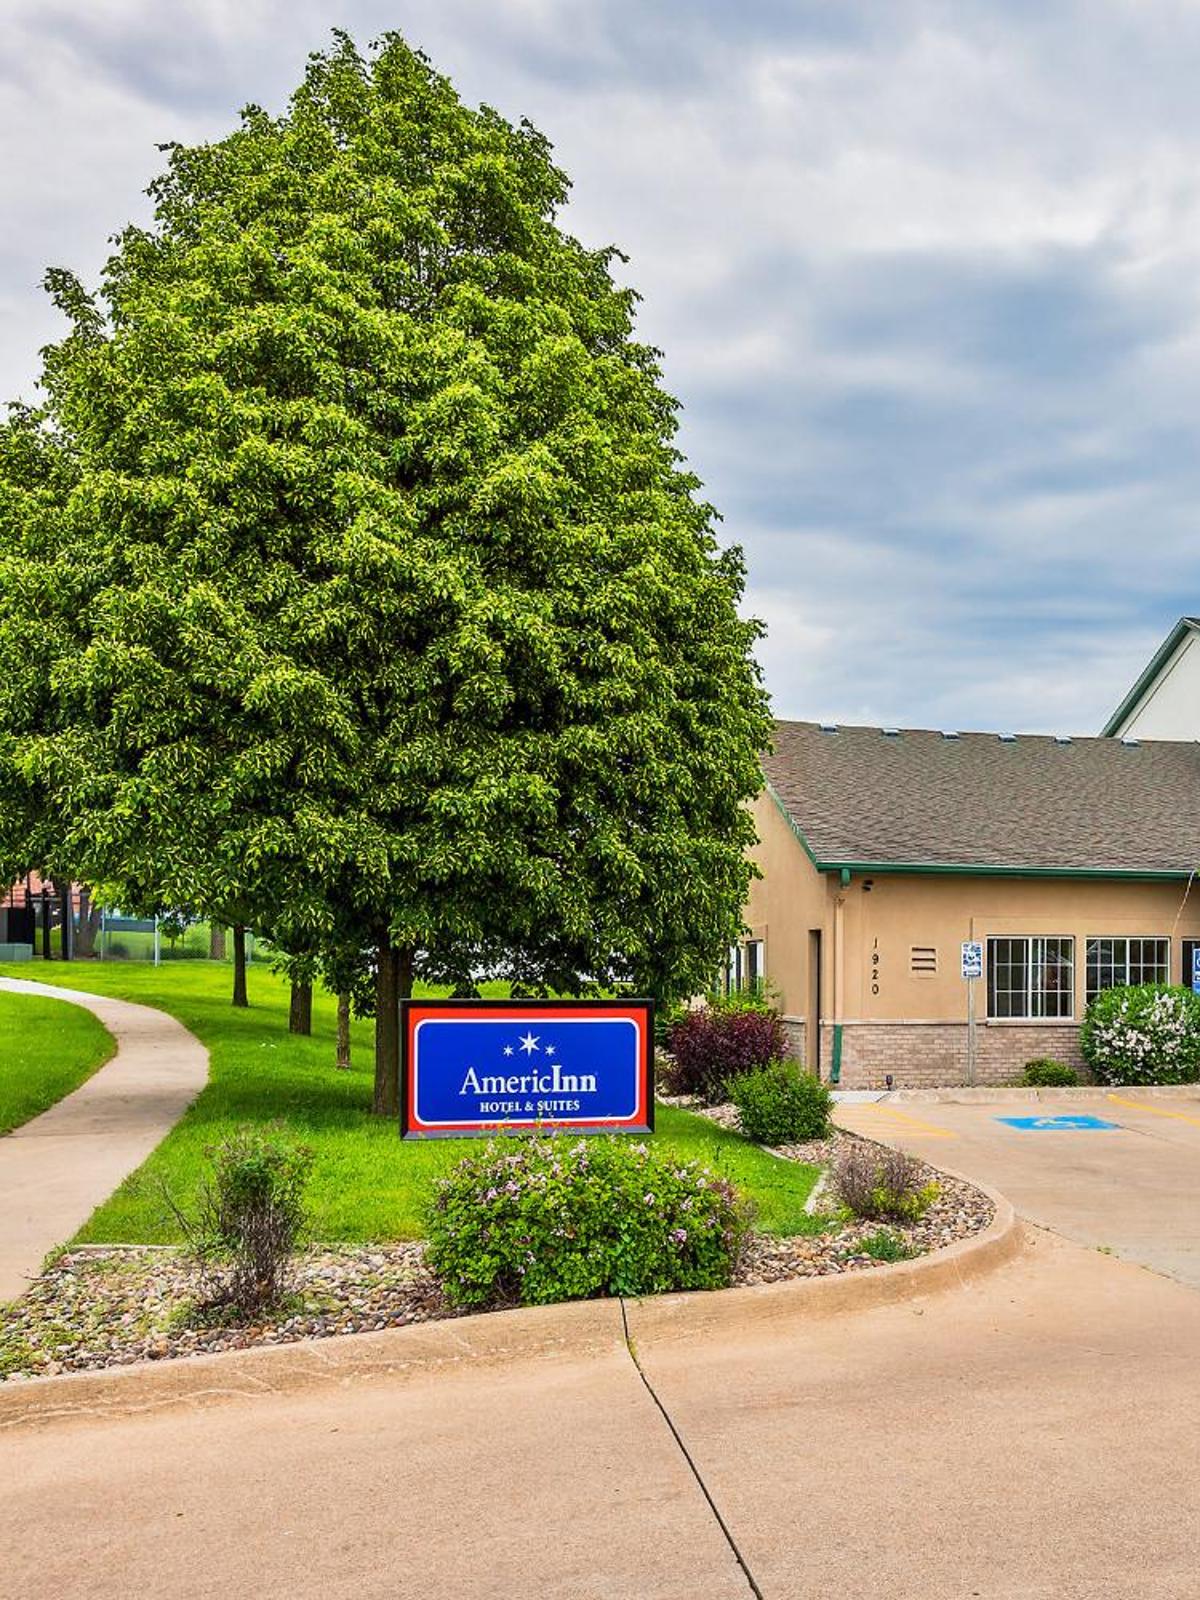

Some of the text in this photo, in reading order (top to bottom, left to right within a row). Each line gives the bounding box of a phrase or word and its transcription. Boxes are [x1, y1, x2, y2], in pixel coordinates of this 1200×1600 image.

[871, 937, 879, 995] 1920
[459, 1065, 597, 1095] AmericInn
[480, 1099, 580, 1113] HOTEL & SUITES
